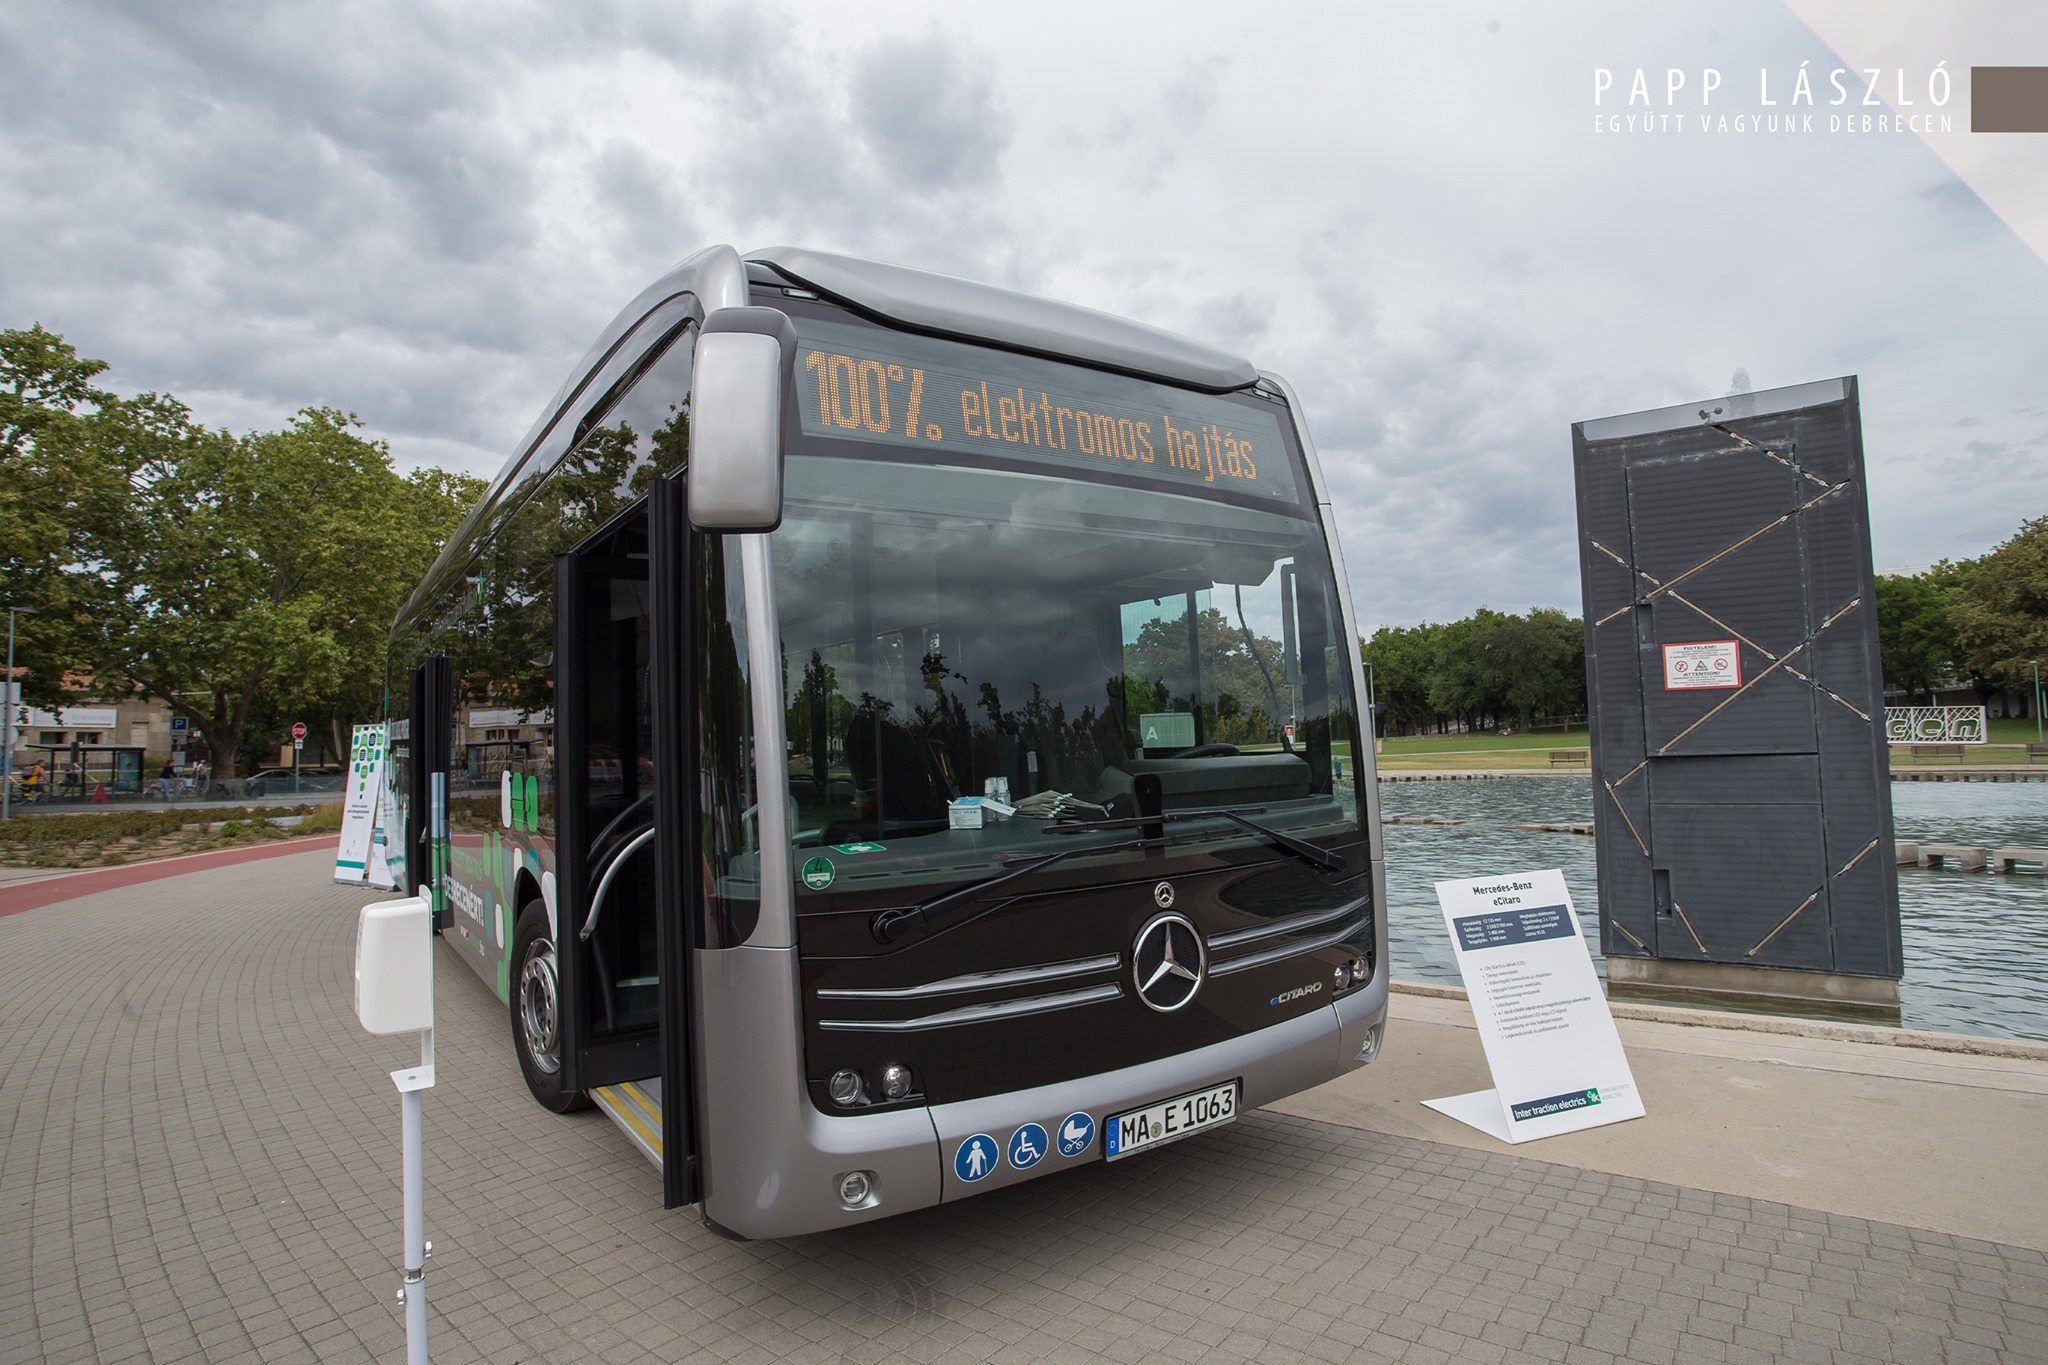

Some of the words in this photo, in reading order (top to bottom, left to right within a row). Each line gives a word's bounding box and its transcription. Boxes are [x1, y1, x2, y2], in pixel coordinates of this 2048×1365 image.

[961, 380, 1155, 464] elektromos
[1163, 415, 1257, 482] hajtás
[175, 719, 184, 729] P
[293, 727, 307, 735] STOP
[814, 858, 824, 873] 4
[1472, 882, 1533, 895] Mercedes-Benz
[1493, 896, 1521, 906] eCitaro
[1269, 981, 1323, 1006] eCITARO
[1514, 1108, 1532, 1119] Inter
[1532, 1104, 1559, 1116] traction
[1558, 1097, 1587, 1110] electrics
[1121, 1113, 1150, 1148] MA
[1165, 1105, 1178, 1134] E
[1183, 1088, 1234, 1129] 1063
[1110, 1140, 1116, 1149] D
